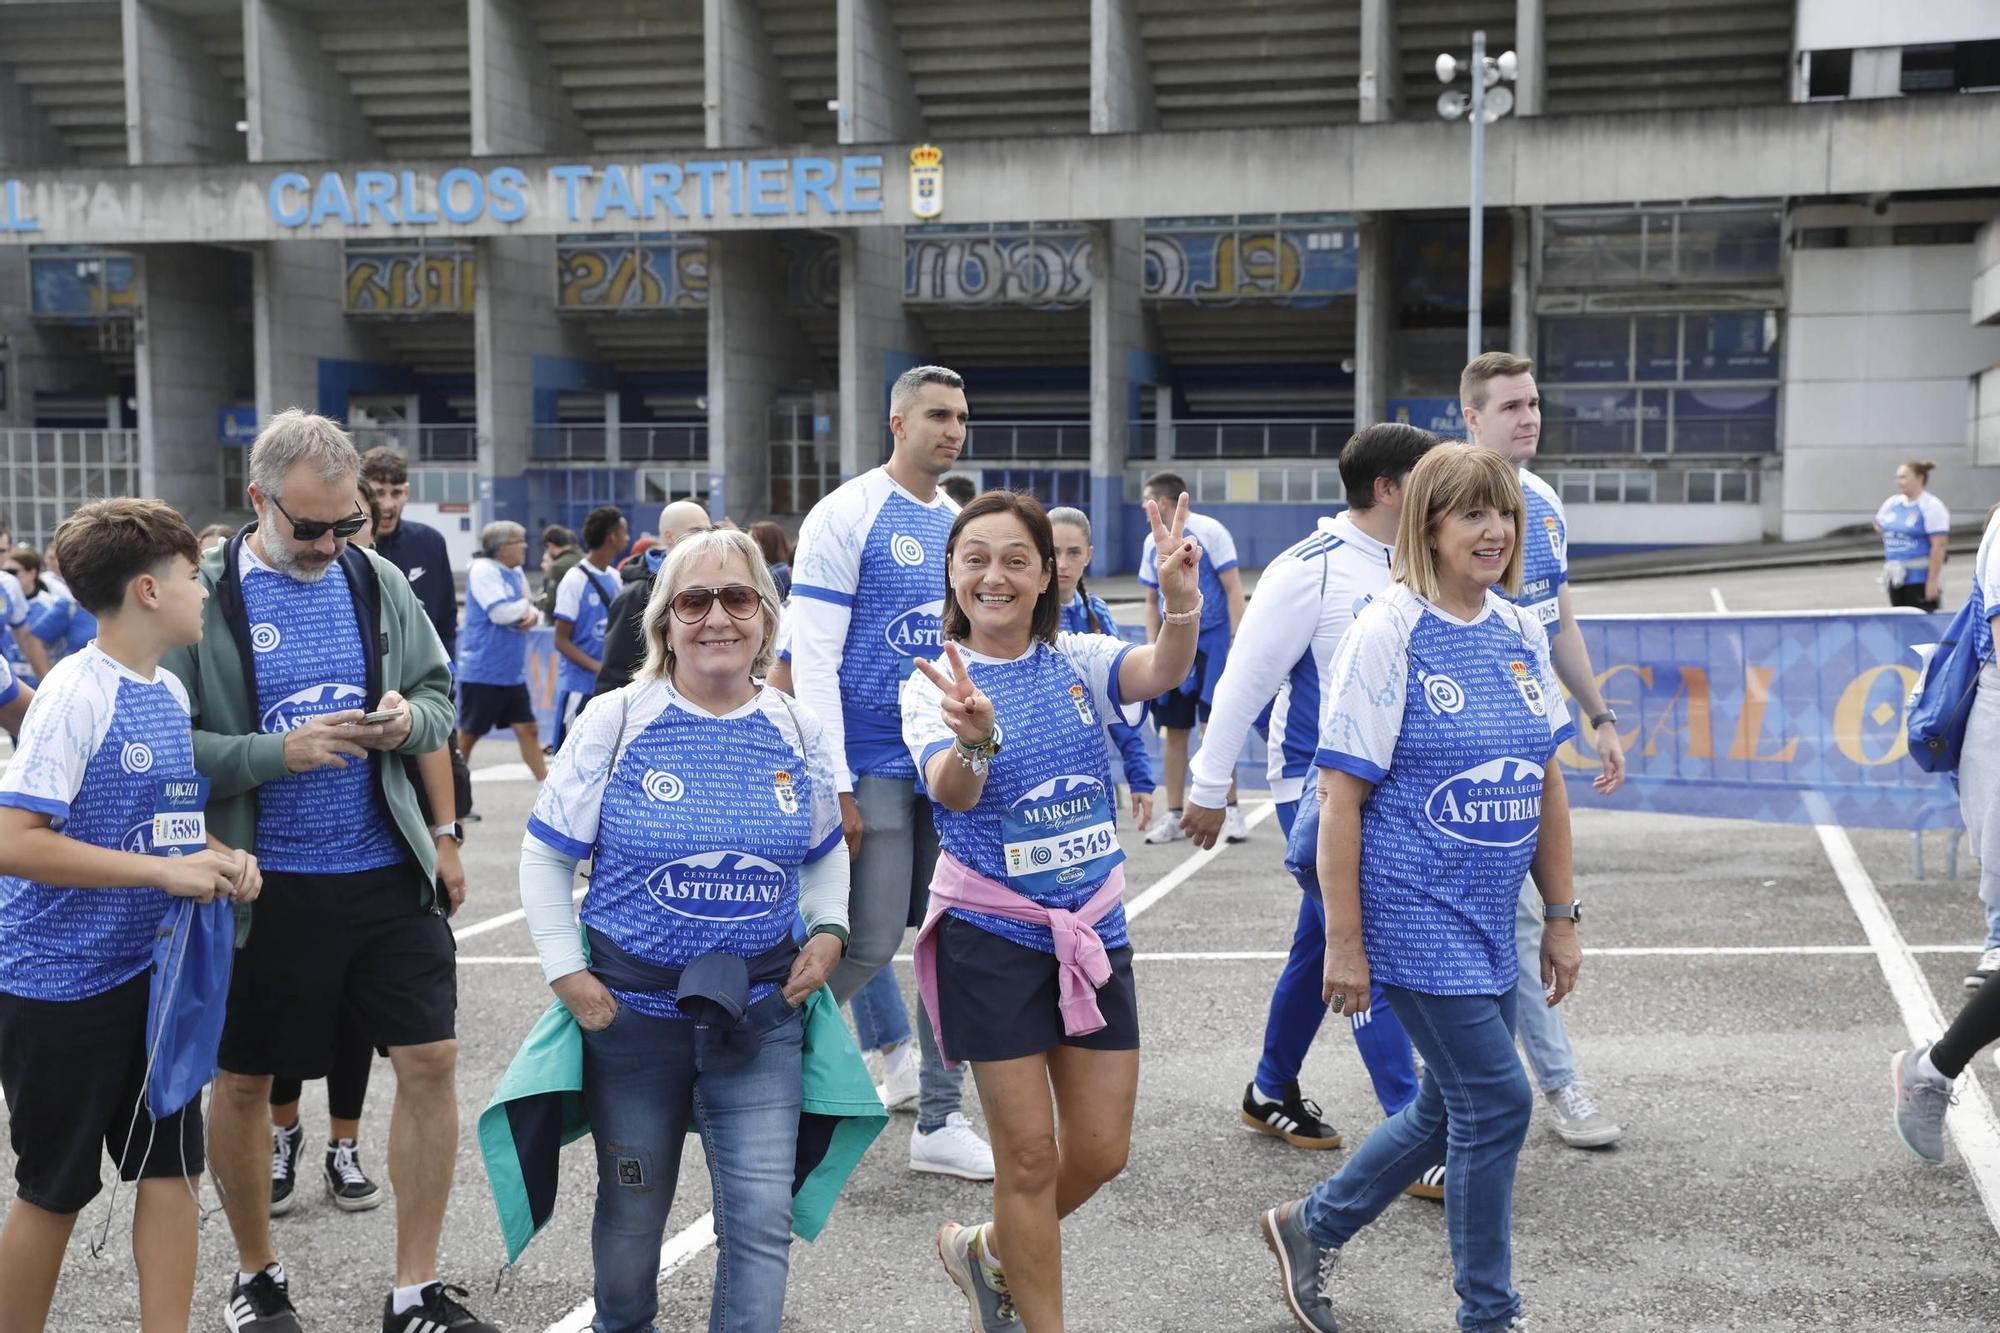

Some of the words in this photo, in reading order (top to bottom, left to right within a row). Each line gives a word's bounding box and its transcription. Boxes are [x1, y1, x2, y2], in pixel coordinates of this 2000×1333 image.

[0, 180, 39, 232] L
[268, 166, 528, 228] CARLOS
[548, 155, 884, 221] TARTIERE
[292, 702, 335, 713] CENTRAL
[338, 699, 363, 708] LECHE
[1557, 664, 1800, 769] EAL
[1468, 785, 1515, 797] CENTRAL
[1518, 783, 1543, 794] LECHER
[1024, 796, 1092, 825] MARCHA
[1436, 789, 1542, 824] ASTURIAN
[1058, 829, 1112, 864] 3549
[654, 870, 780, 902] ASTURIANA
[683, 870, 732, 880] CENTRAL
[736, 873, 780, 881] LECHERA
